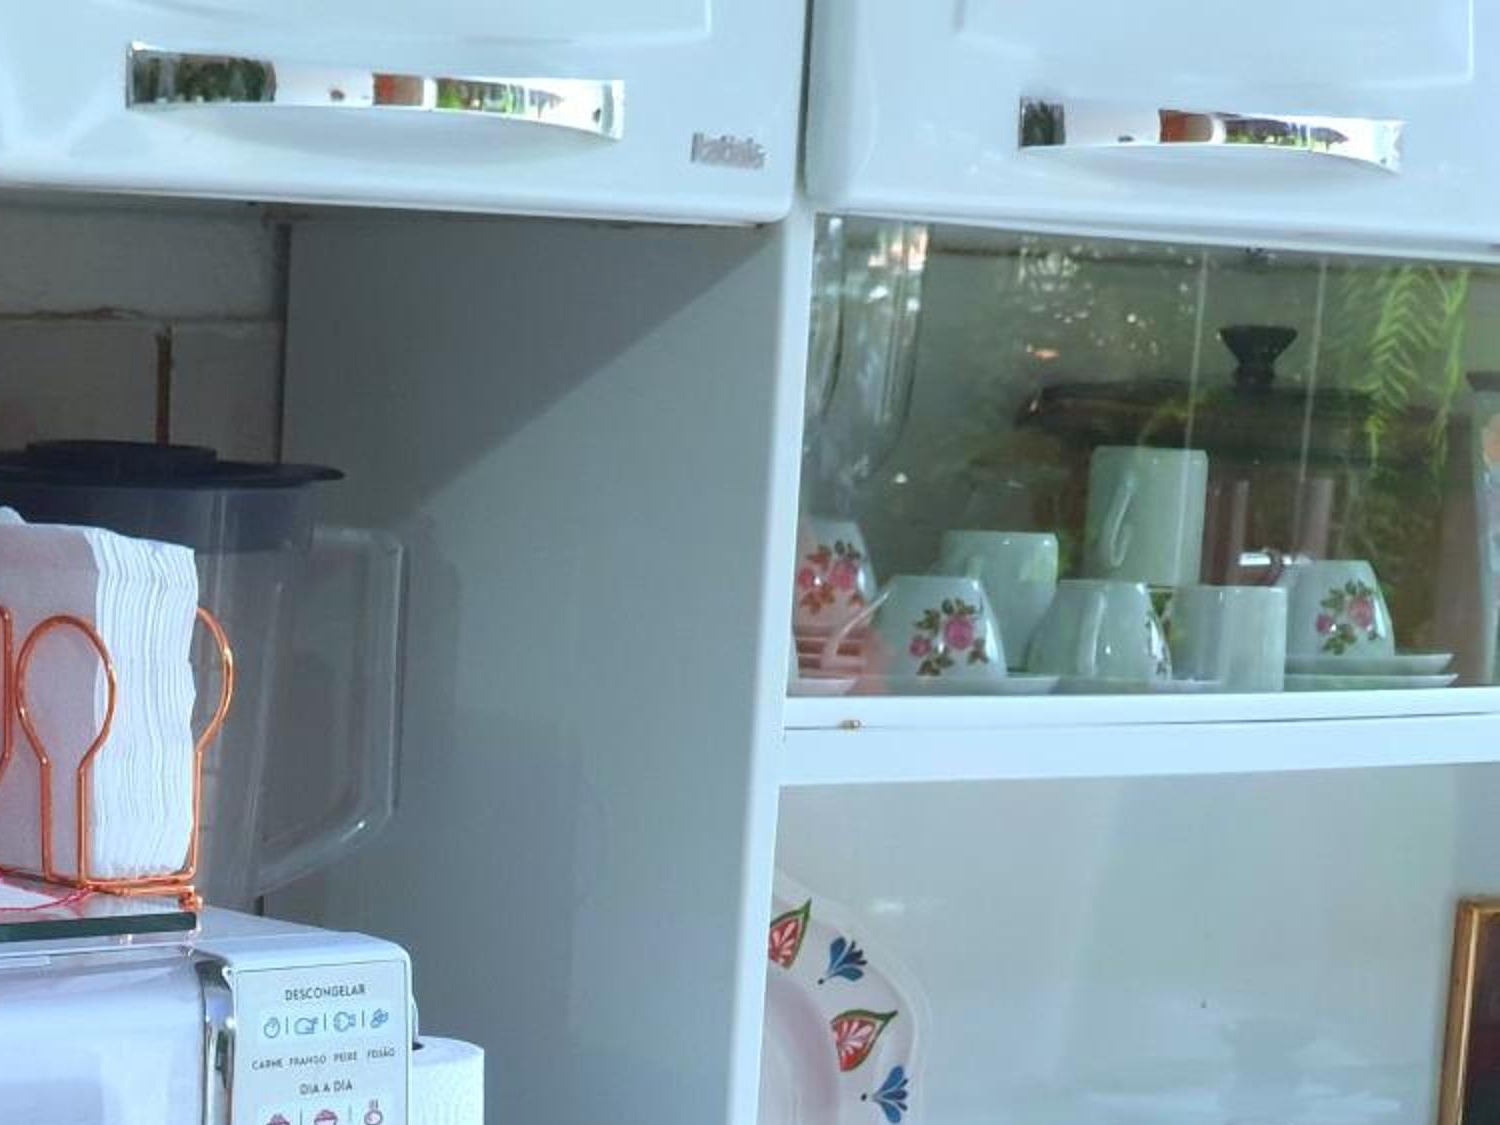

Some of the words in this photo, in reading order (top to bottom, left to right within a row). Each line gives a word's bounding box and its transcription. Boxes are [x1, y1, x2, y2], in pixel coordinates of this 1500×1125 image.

[285, 983, 365, 1001] DESCONGELAR
[289, 1055, 327, 1067] FRANGO
[334, 1051, 357, 1062] PEIXE
[251, 1058, 283, 1071] CARNE
[299, 1083, 319, 1096] DIA
[323, 1082, 331, 1093] A
[334, 1079, 353, 1093] DIA
